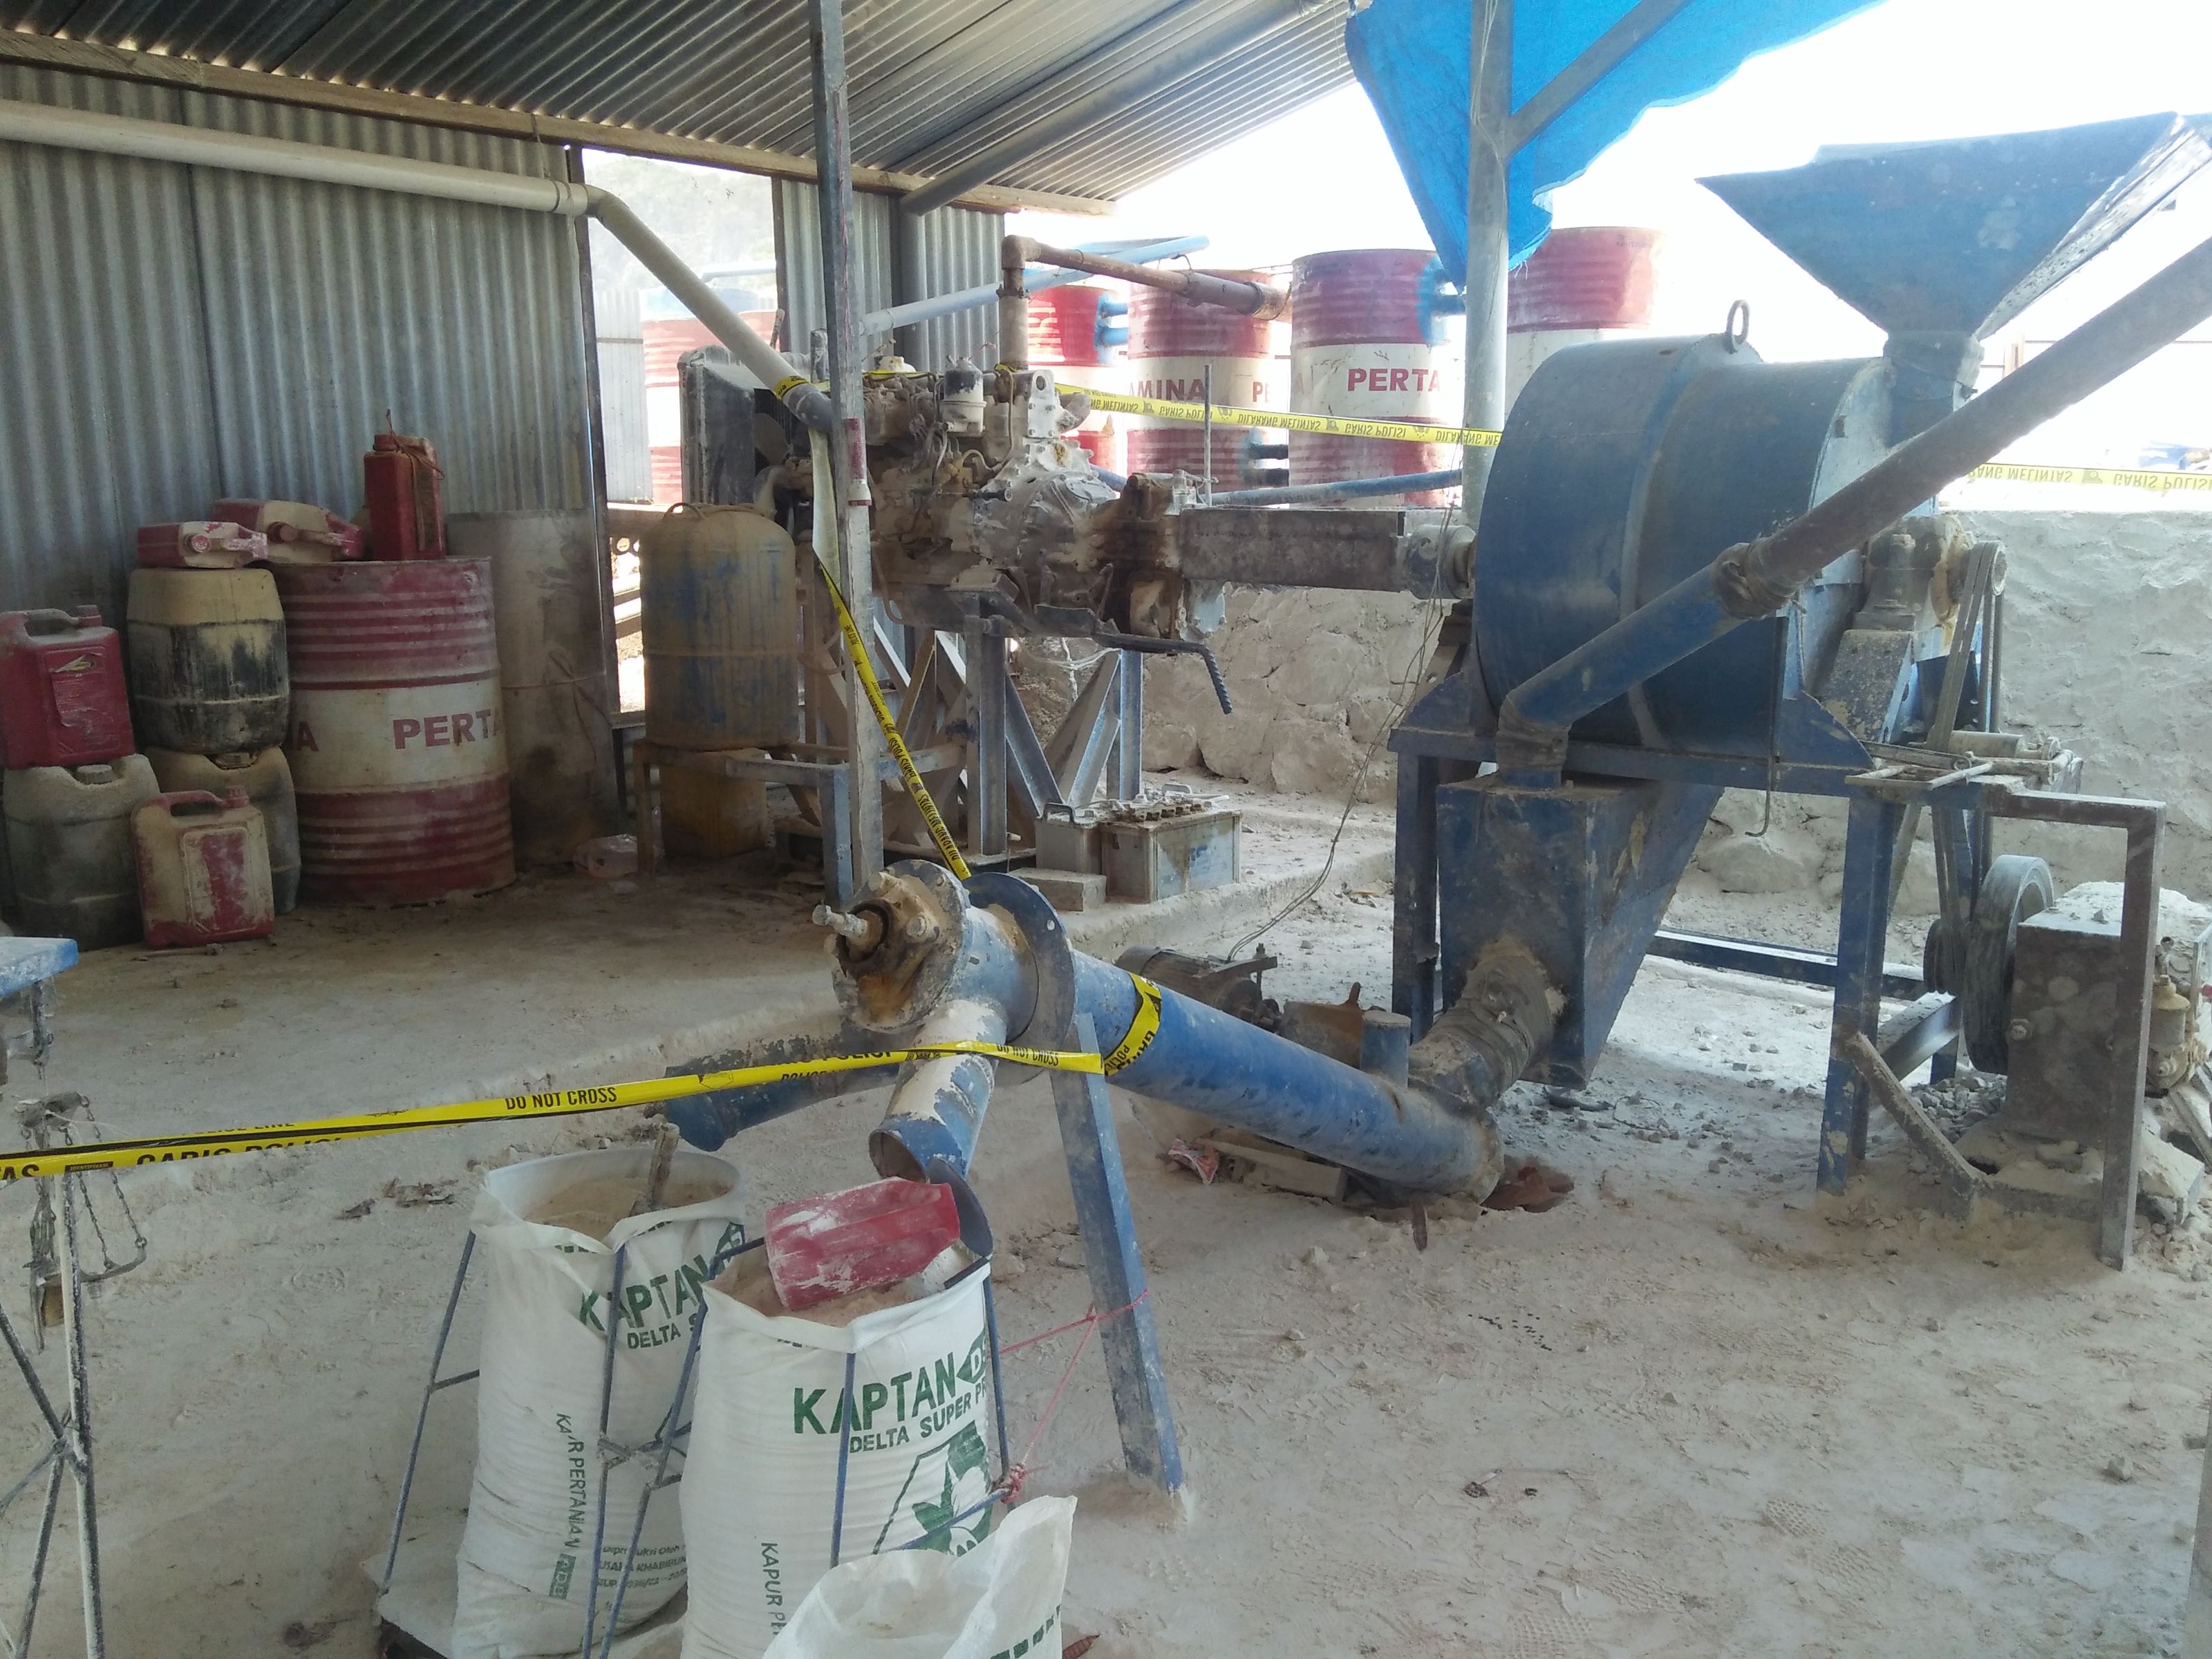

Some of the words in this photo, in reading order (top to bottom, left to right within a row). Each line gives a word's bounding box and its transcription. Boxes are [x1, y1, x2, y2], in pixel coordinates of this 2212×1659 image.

[1347, 368, 1441, 392] PERTA
[505, 1096, 527, 1110] DO
[532, 1092, 561, 1108] NOT
[568, 1087, 618, 1106] CROSS
[627, 1322, 681, 1349] DELTA
[794, 1351, 957, 1434] KAPTAN
[850, 1425, 910, 1454] DELTA
[919, 1392, 971, 1439] SUPER
[761, 1542, 783, 1606] KAPUR
[768, 1611, 788, 1635] PE
